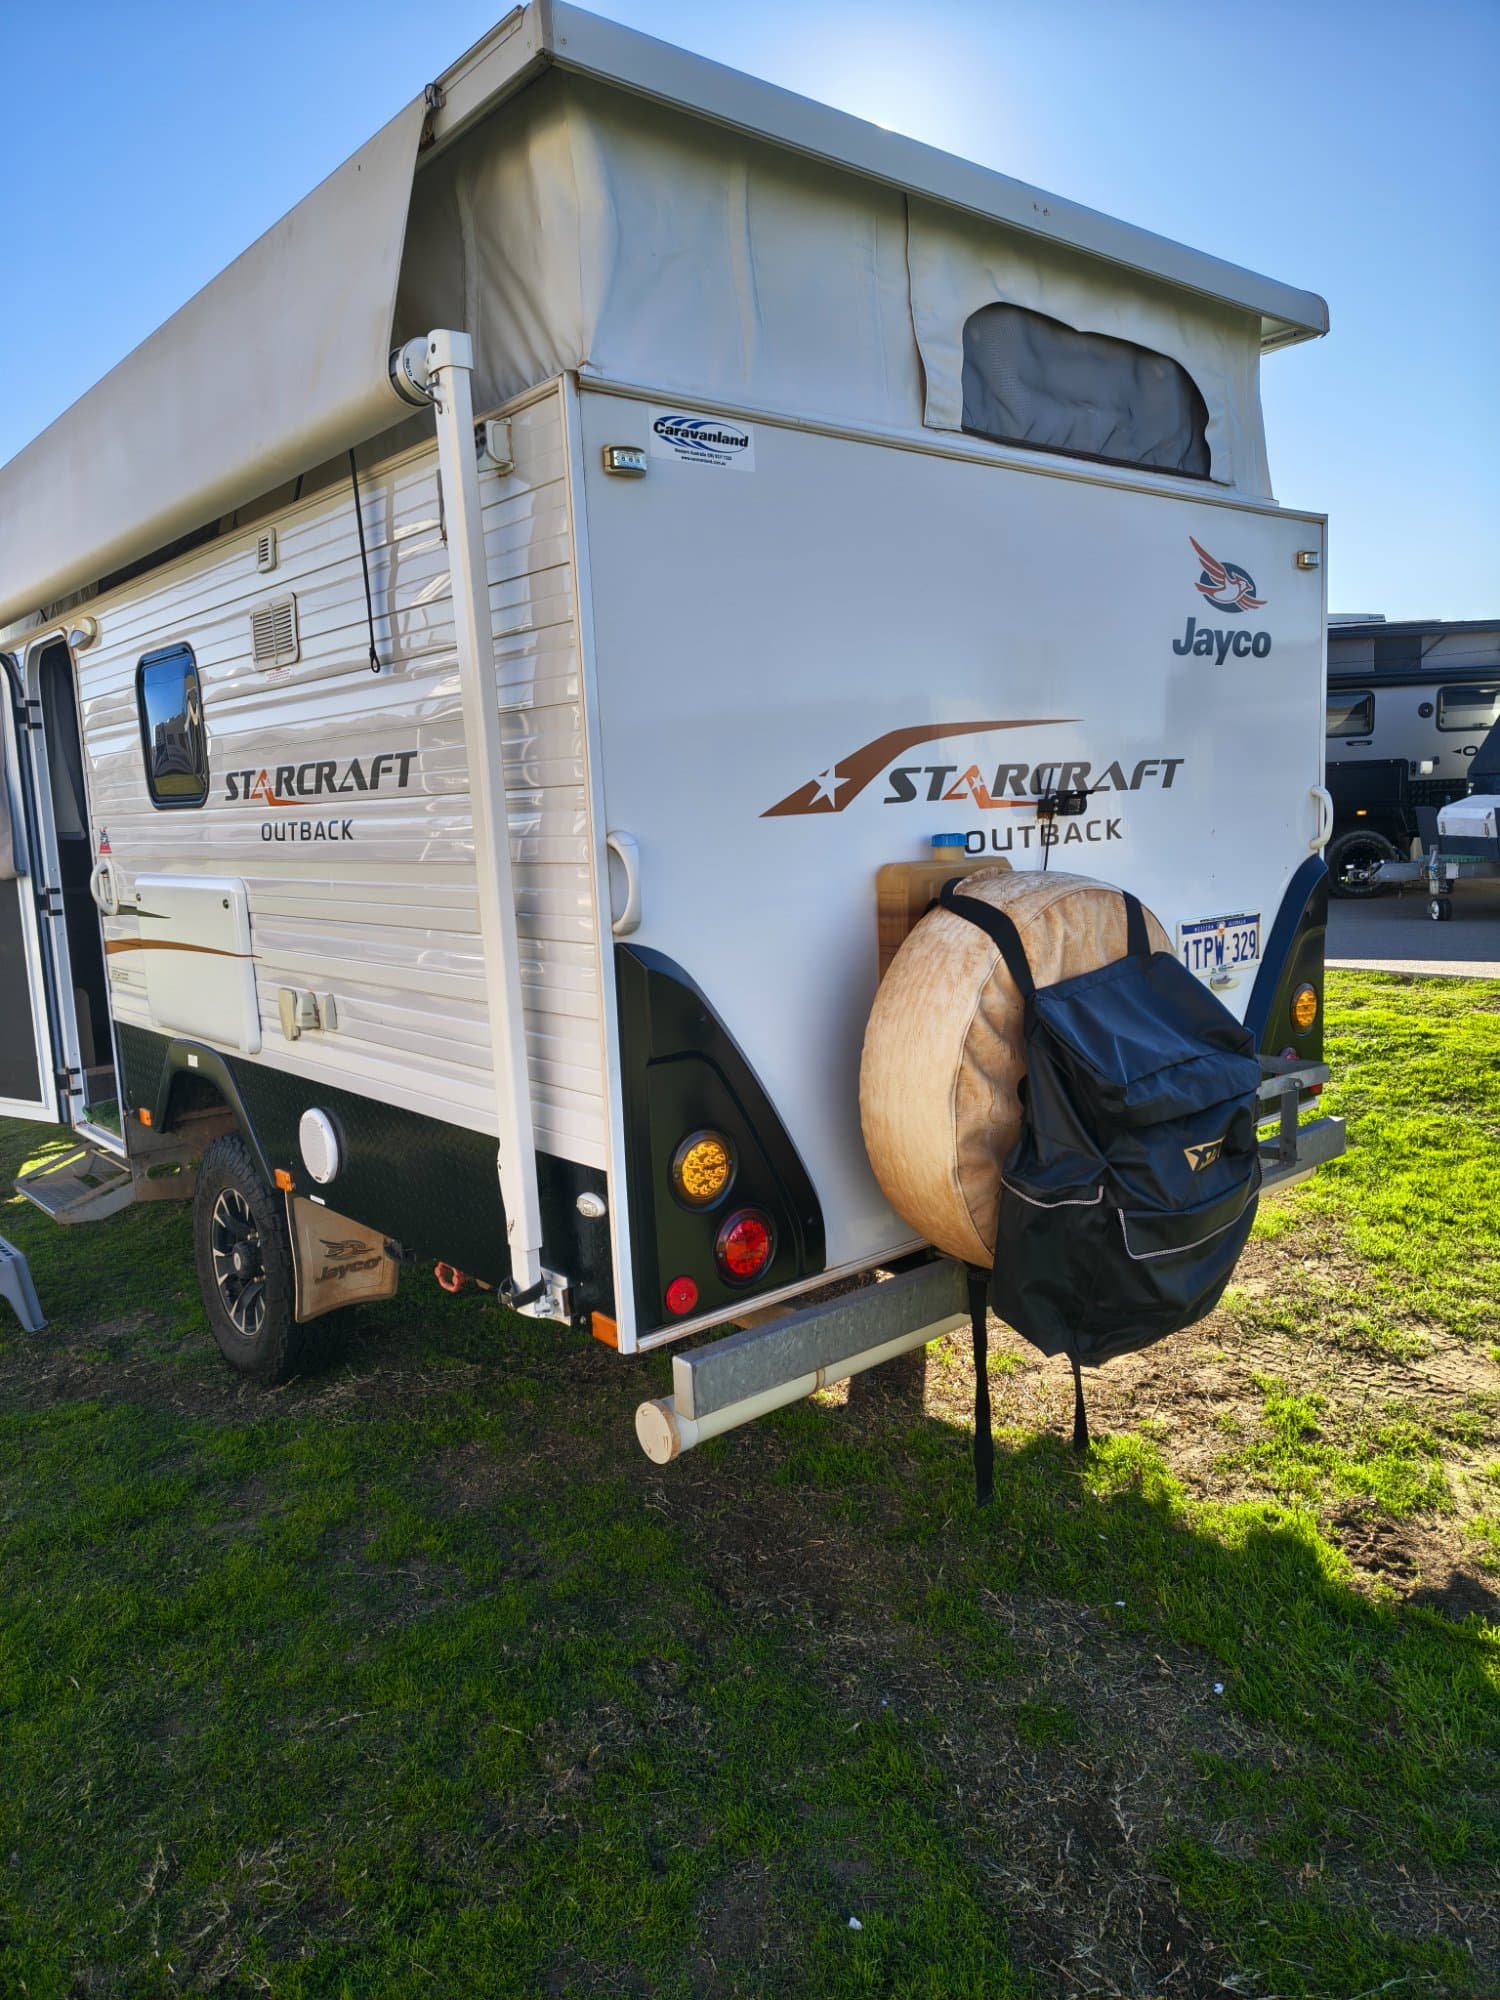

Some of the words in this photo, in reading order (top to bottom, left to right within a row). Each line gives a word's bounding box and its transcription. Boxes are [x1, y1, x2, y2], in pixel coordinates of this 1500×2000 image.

[653, 421, 749, 447] Caravanland
[1172, 617, 1272, 666] Jayco
[225, 750, 418, 807] STARCRAFT
[884, 758, 1185, 808] STARCRAFT
[261, 818, 354, 842] OUTBACK
[964, 817, 1123, 855] OUTBACK
[314, 1256, 382, 1284] Jayco
